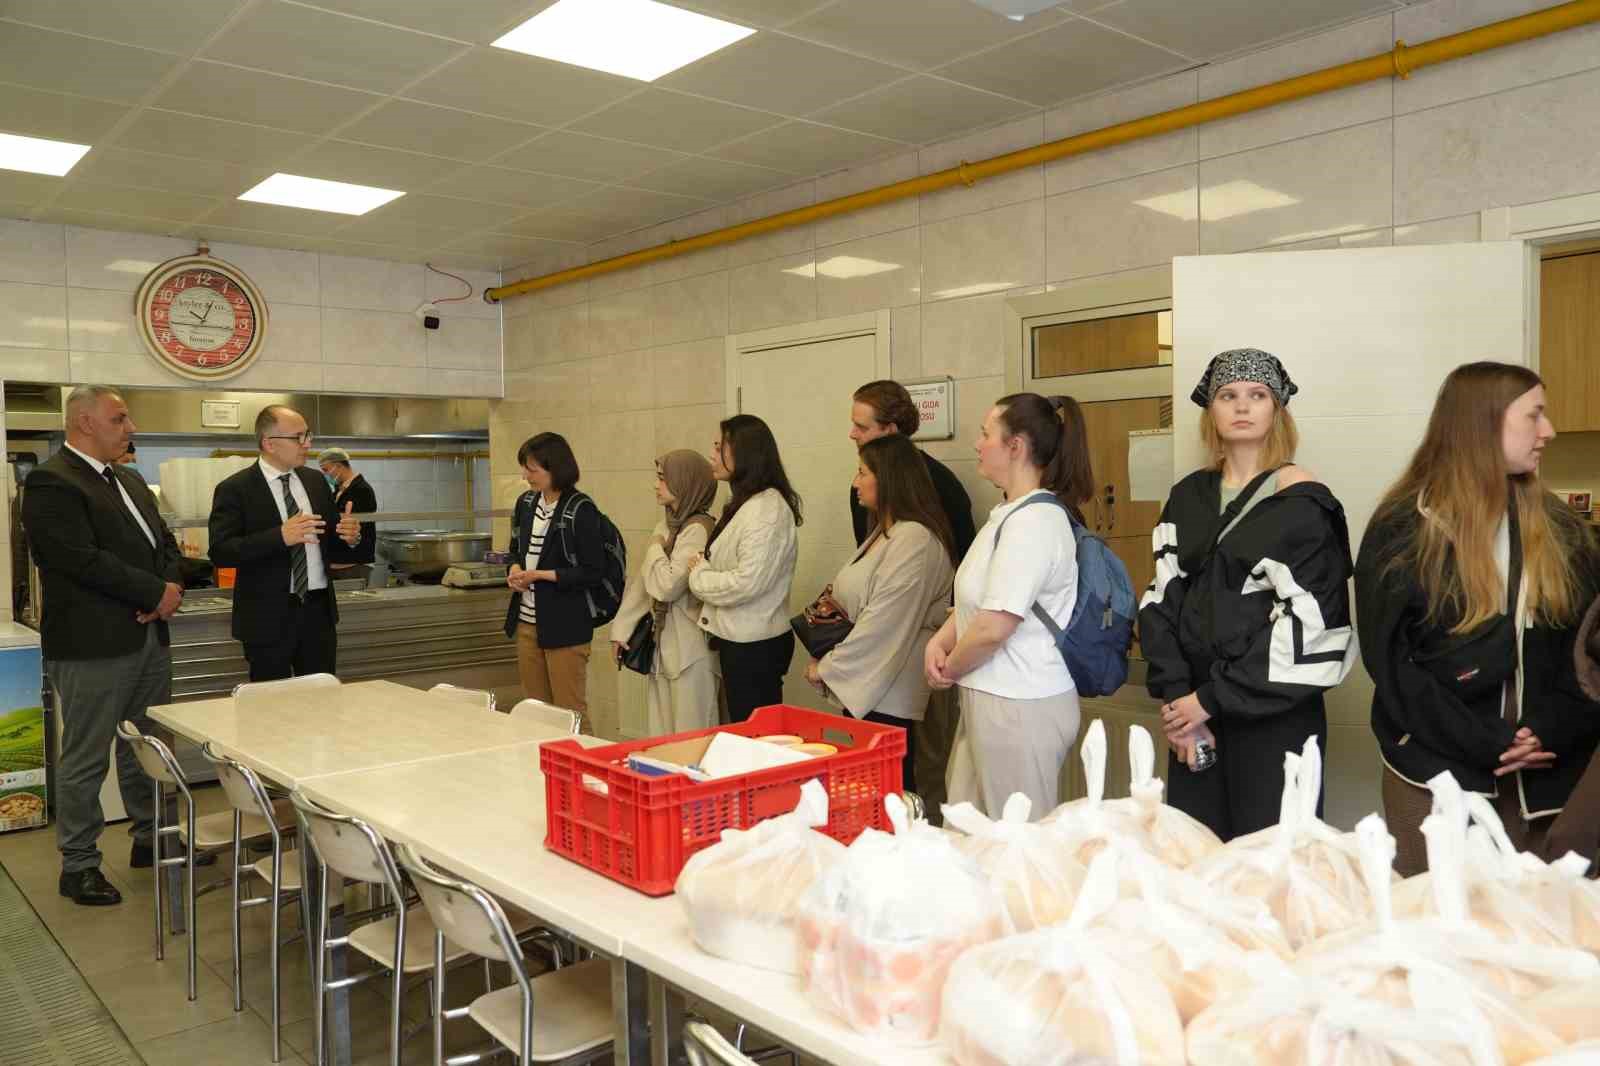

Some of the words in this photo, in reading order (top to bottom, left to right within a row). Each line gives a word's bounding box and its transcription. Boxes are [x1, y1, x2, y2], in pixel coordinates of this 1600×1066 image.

[176, 277, 185, 289] 11
[196, 273, 212, 285] 12
[223, 281, 229, 294] 1
[158, 289, 174, 302] 10
[237, 297, 245, 308] 2
[154, 310, 163, 319] 9
[239, 318, 248, 330] 3
[175, 344, 185, 357] 7
[220, 349, 229, 361] 5
[197, 353, 207, 365] 6
[922, 401, 939, 409] GIDA
